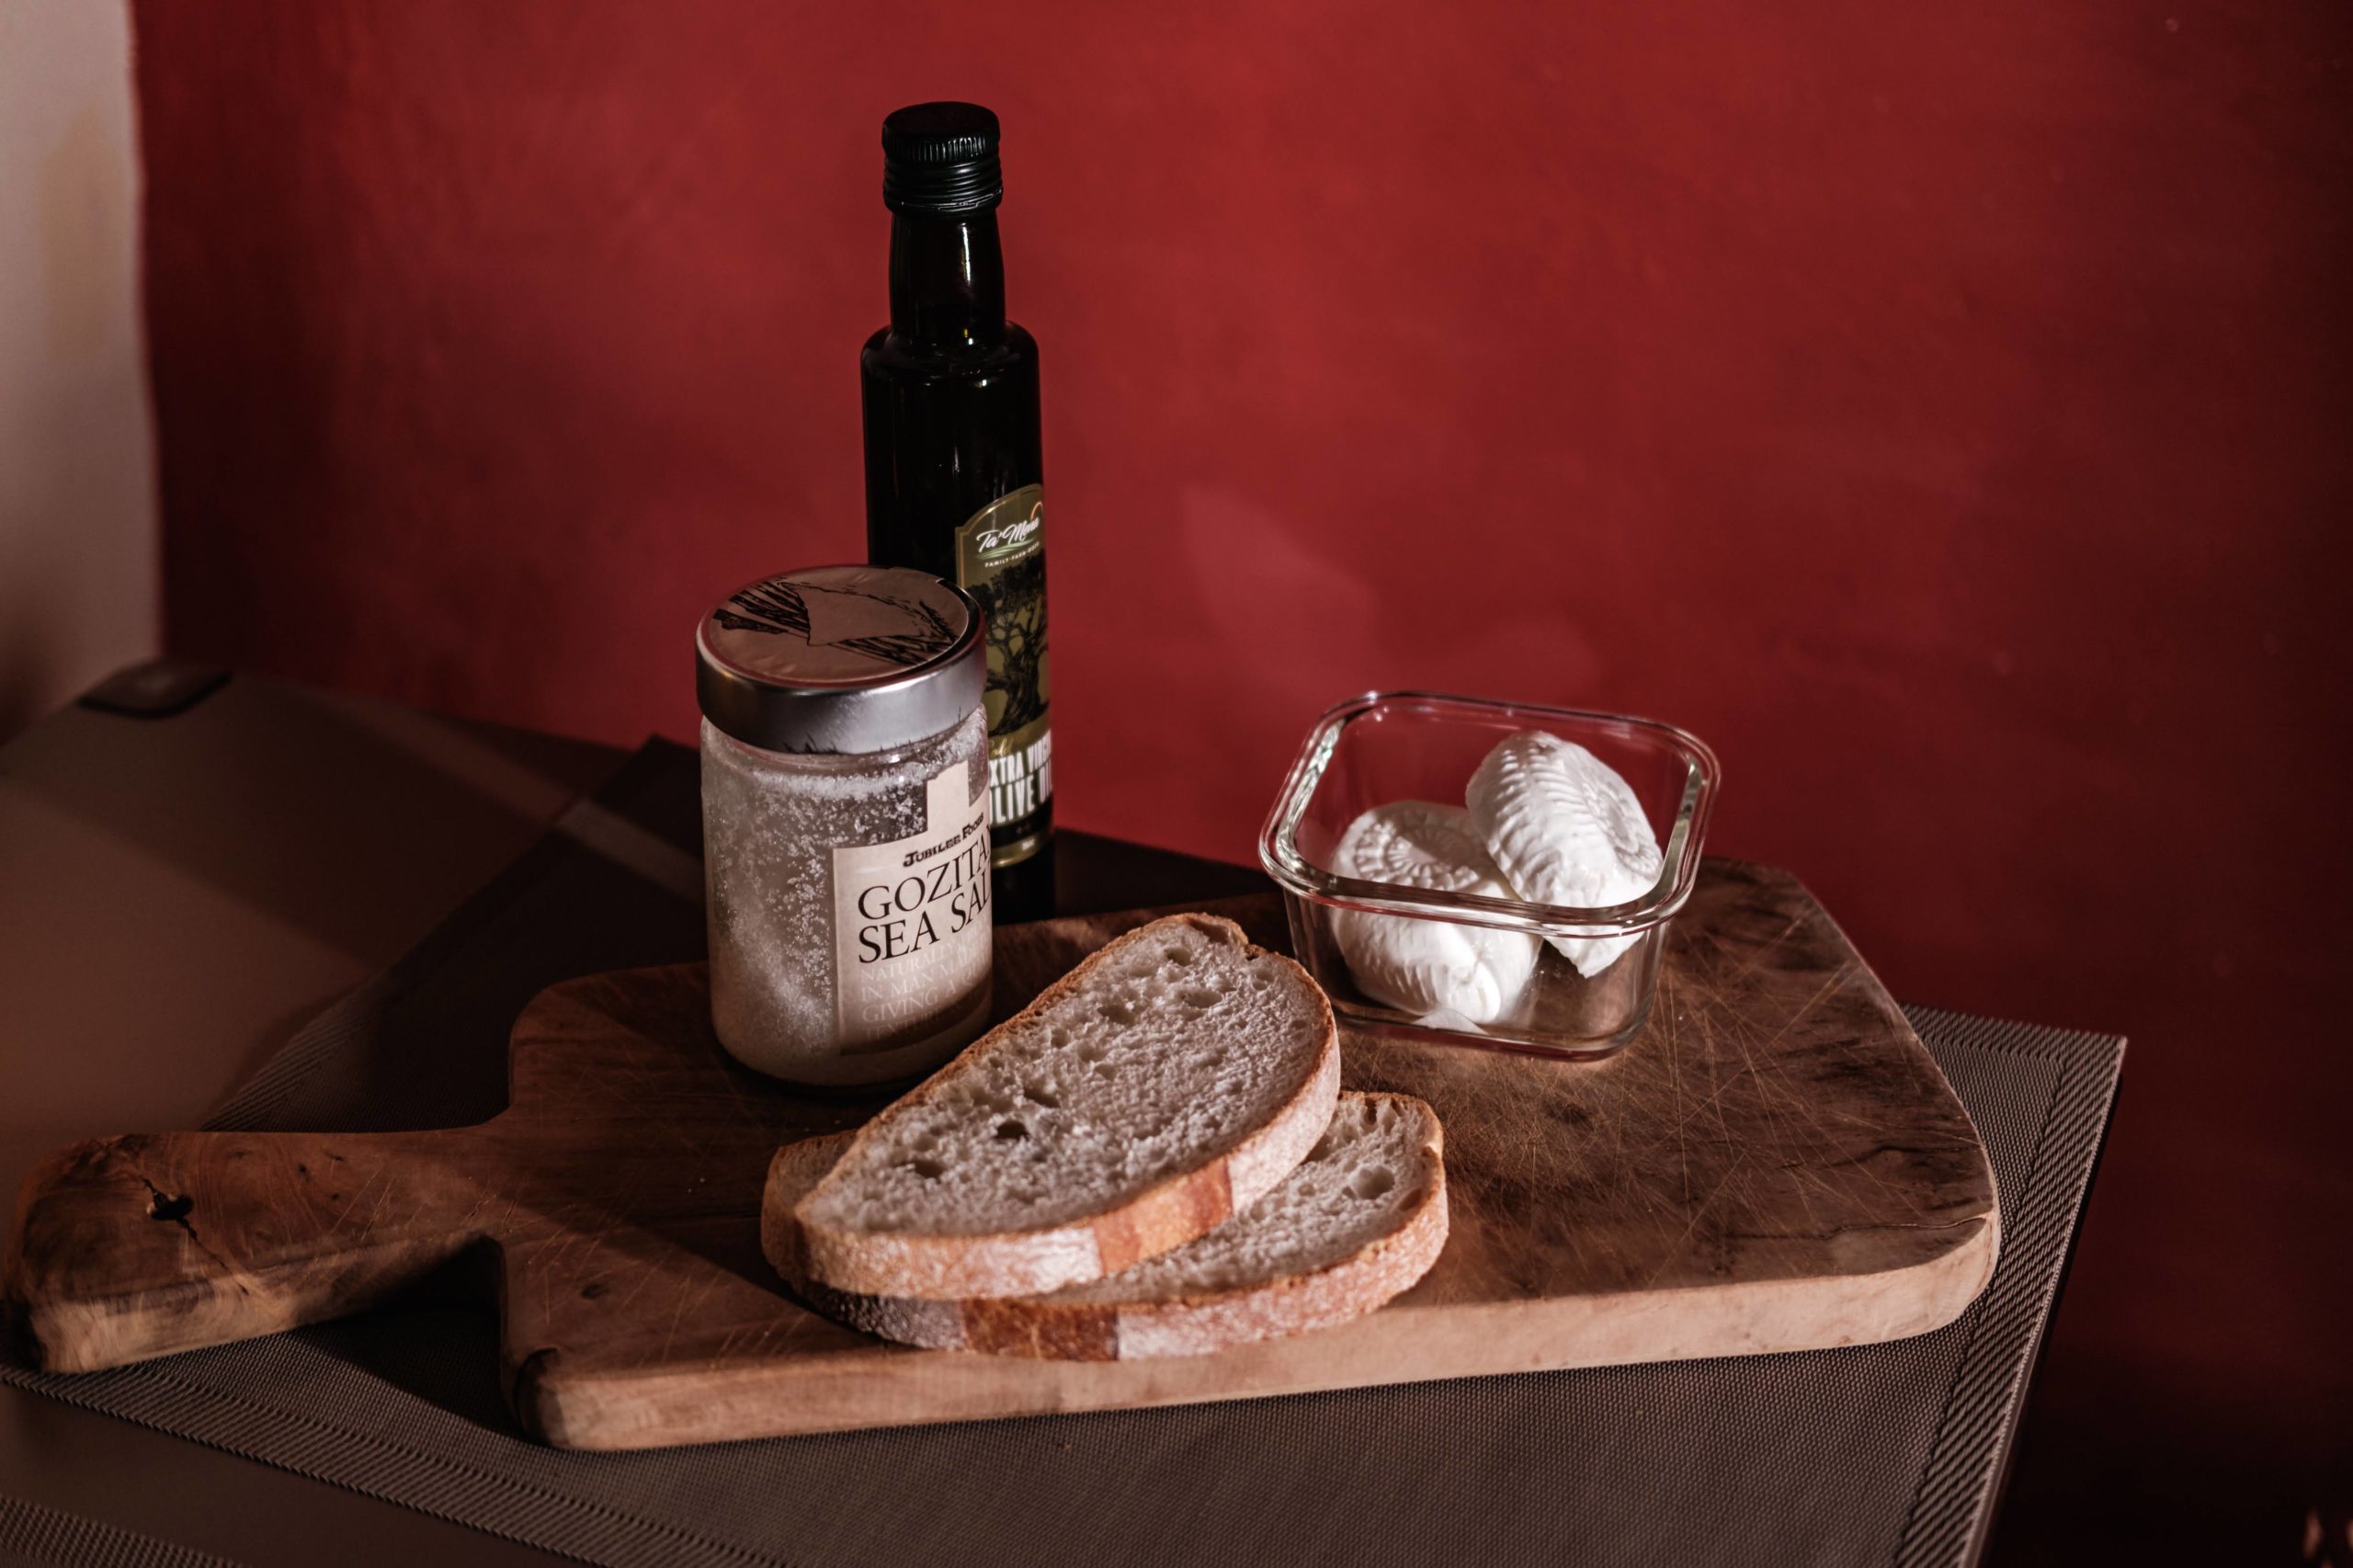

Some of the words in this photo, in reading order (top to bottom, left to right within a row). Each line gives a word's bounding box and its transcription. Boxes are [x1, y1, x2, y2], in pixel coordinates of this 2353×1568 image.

[984, 558, 1009, 567] FAMILY
[988, 751, 1024, 787] XTRA
[903, 834, 962, 868] JUBILEE
[858, 909, 941, 964] SEA
[950, 869, 990, 934] SAL
[861, 986, 938, 1024] GIVING
